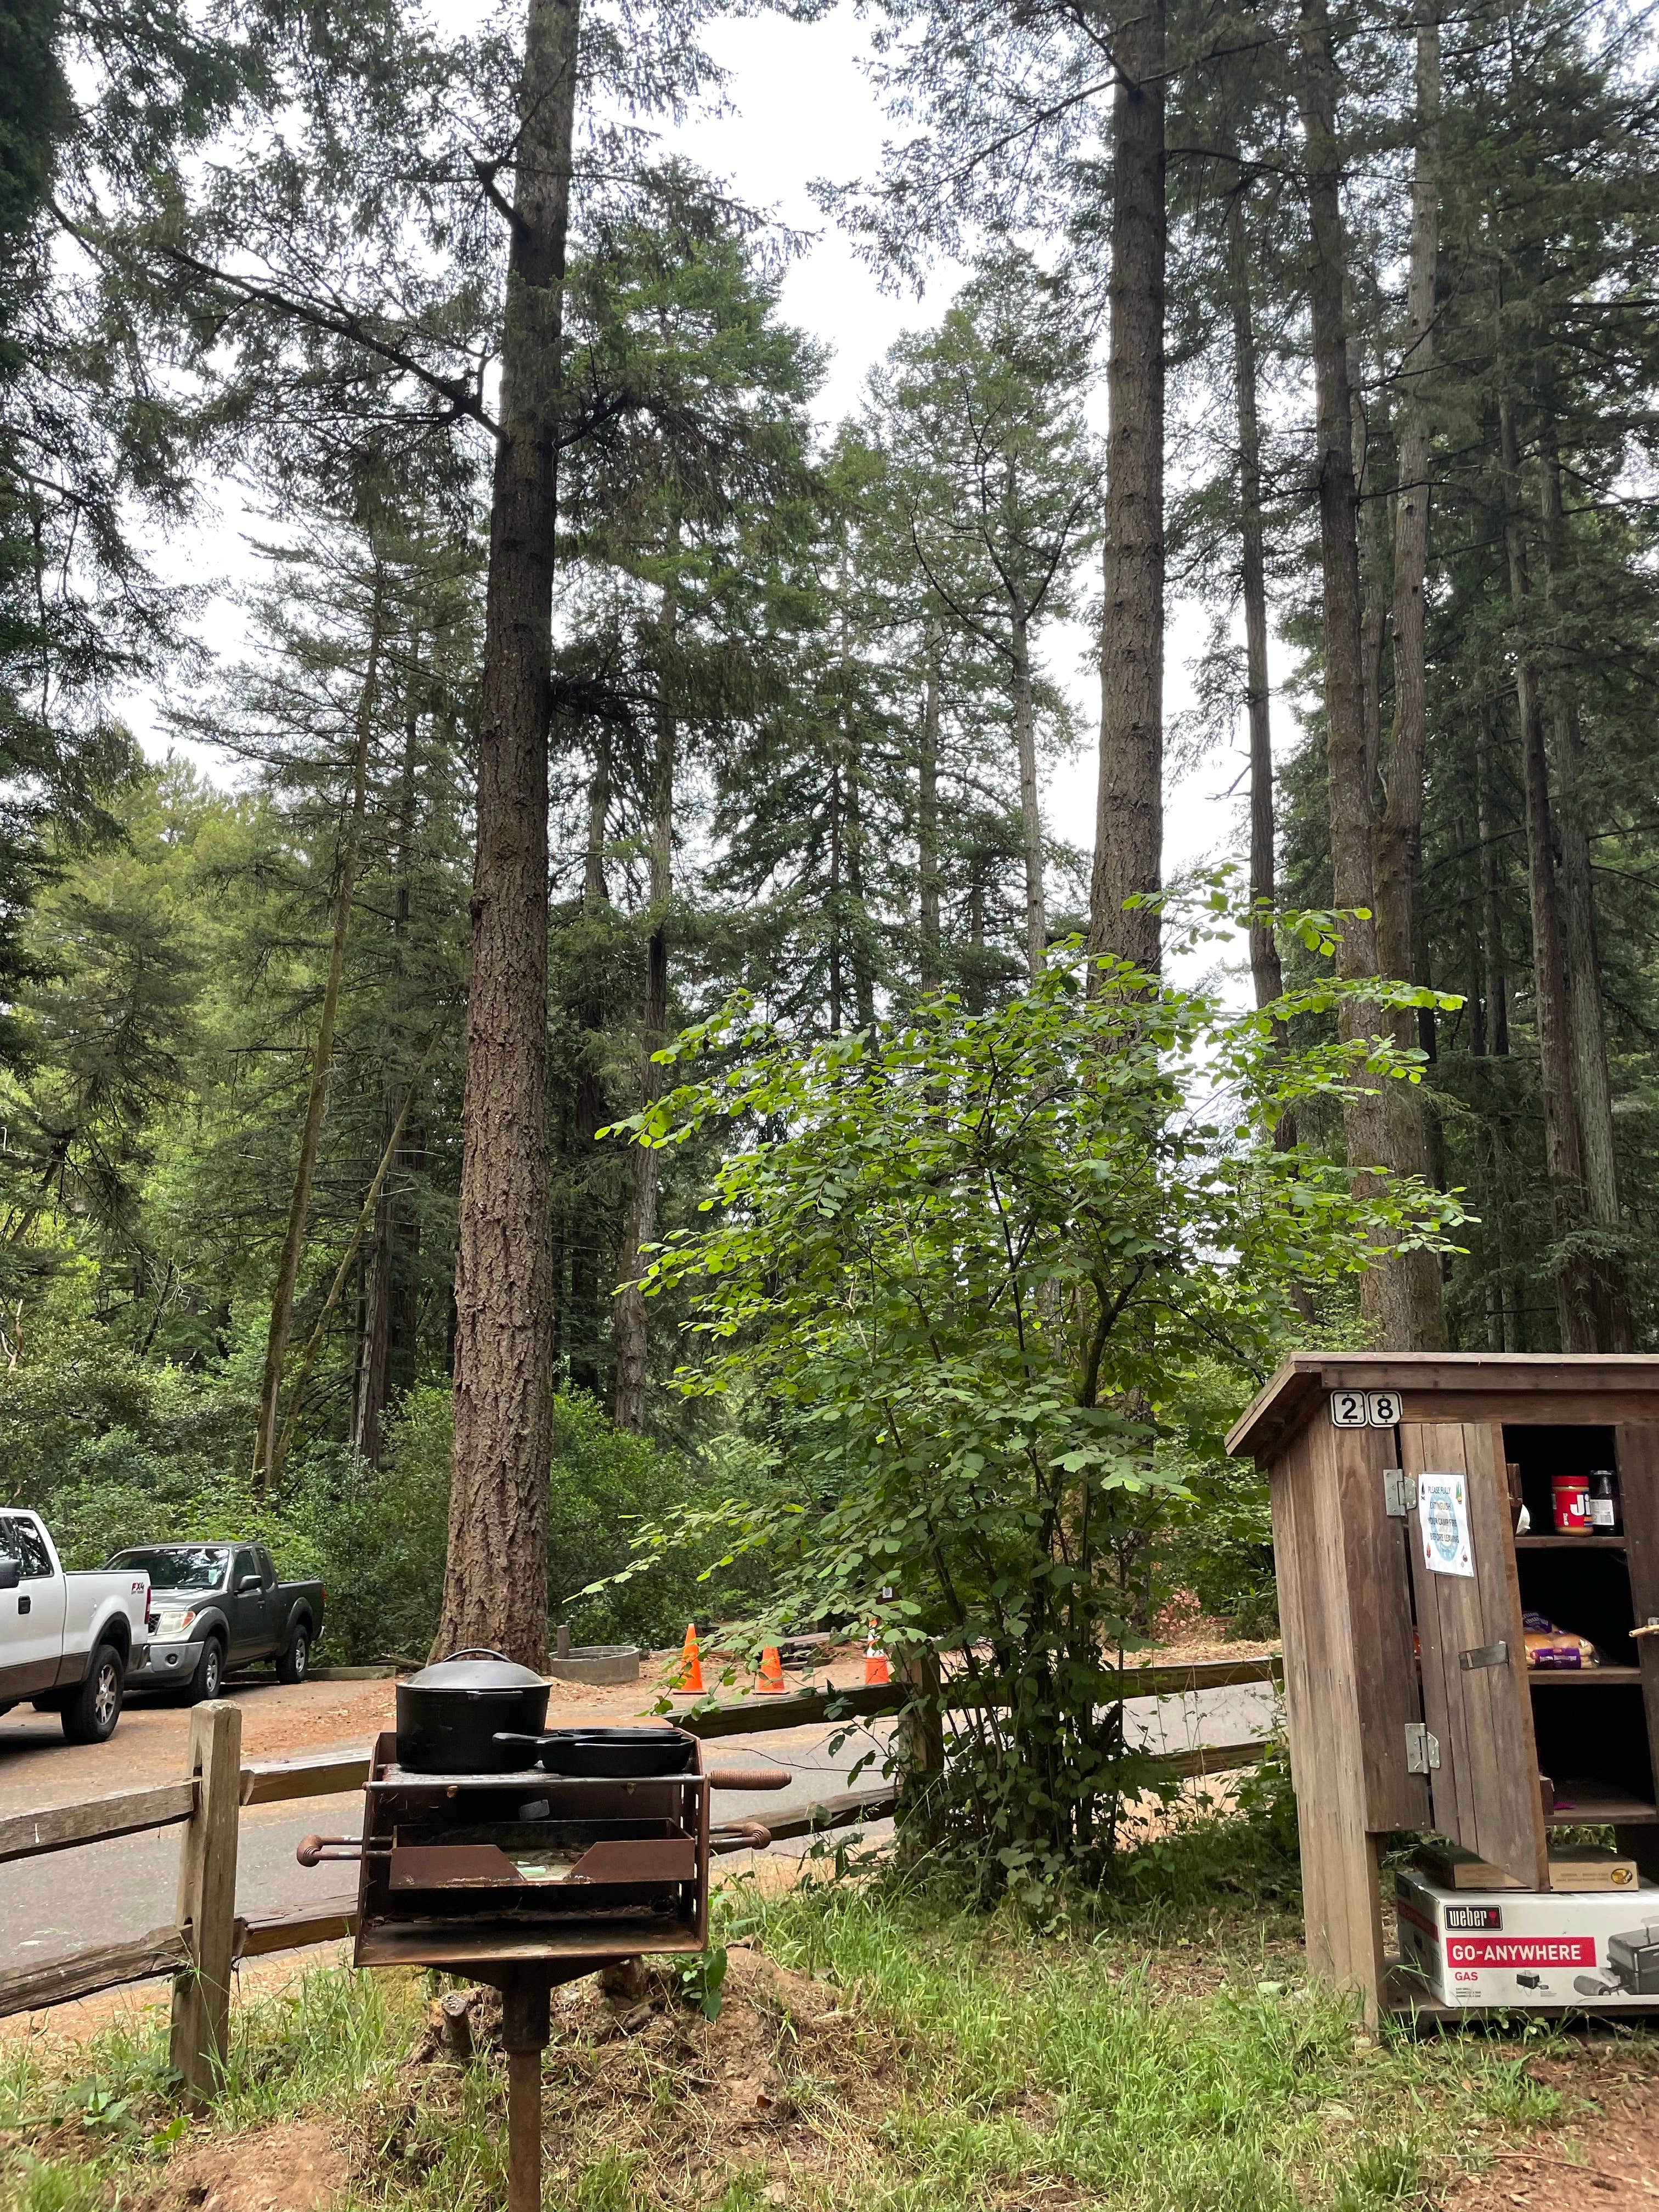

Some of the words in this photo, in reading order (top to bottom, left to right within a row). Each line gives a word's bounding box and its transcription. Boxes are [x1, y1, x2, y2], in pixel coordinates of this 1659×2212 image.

[1341, 1397, 1393, 1419] 28
[1430, 1502, 1451, 1510] EXTINGUISH
[1570, 1494, 1591, 1516] Ji
[1430, 1533, 1443, 1542] BEFORE
[1444, 1534, 1459, 1543] LEAVING
[132, 1582, 144, 1591] FX4
[1449, 1906, 1487, 1927] weber
[1452, 1944, 1581, 1961] GO-ANYWHERE
[1455, 1972, 1478, 1980] GAS
